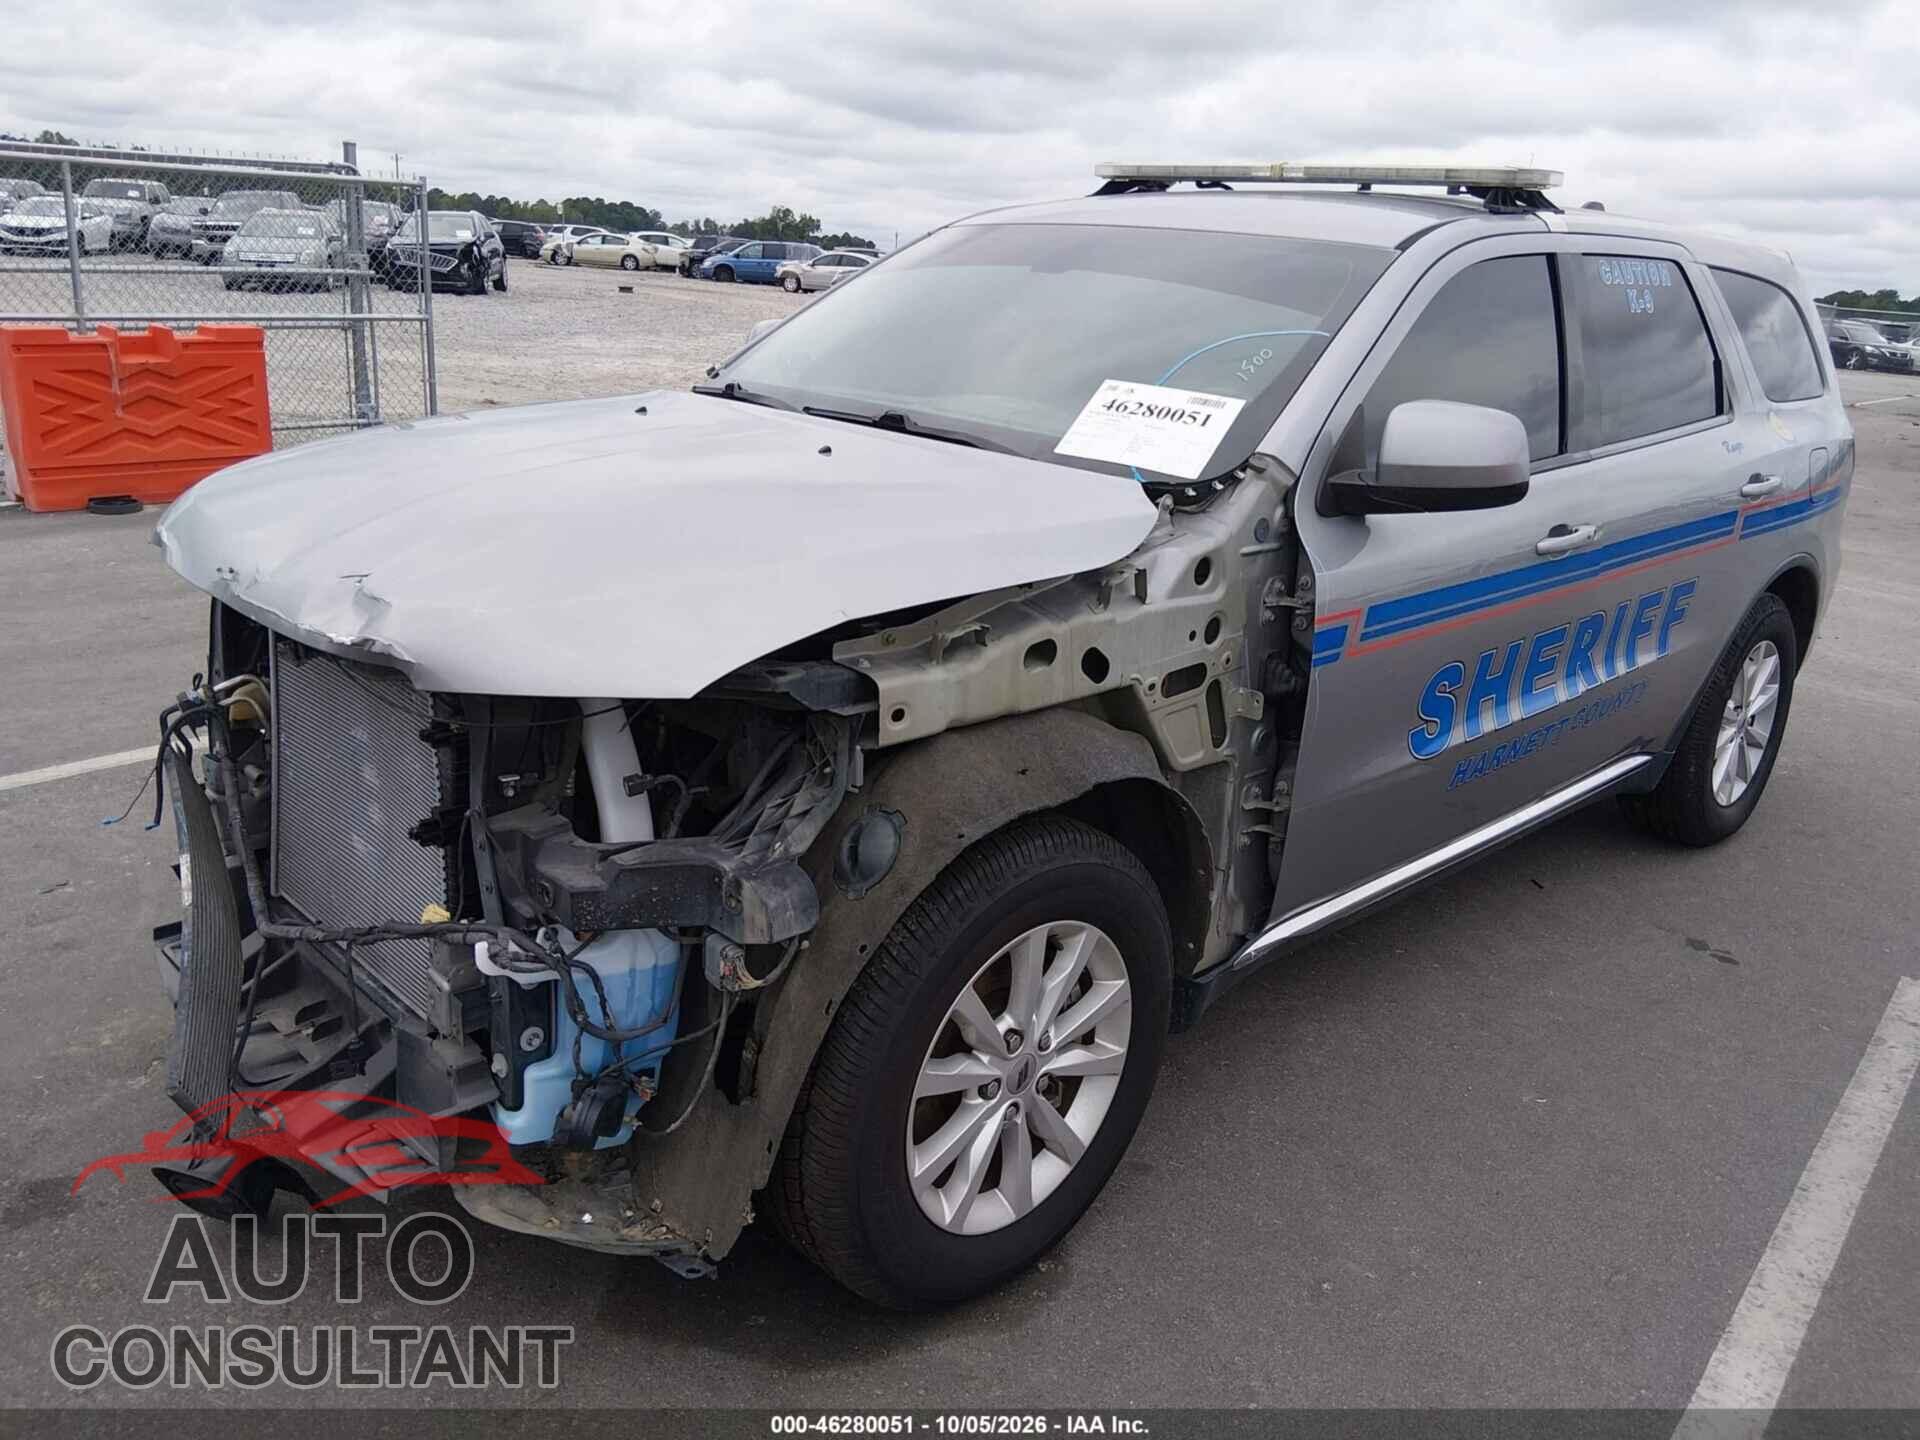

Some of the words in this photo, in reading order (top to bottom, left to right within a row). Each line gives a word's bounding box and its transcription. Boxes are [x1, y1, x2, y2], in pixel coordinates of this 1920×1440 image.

[1102, 398, 1213, 428] 46280051
[1407, 576, 1700, 761] SHERIFF
[1447, 717, 1570, 791] HARNETT
